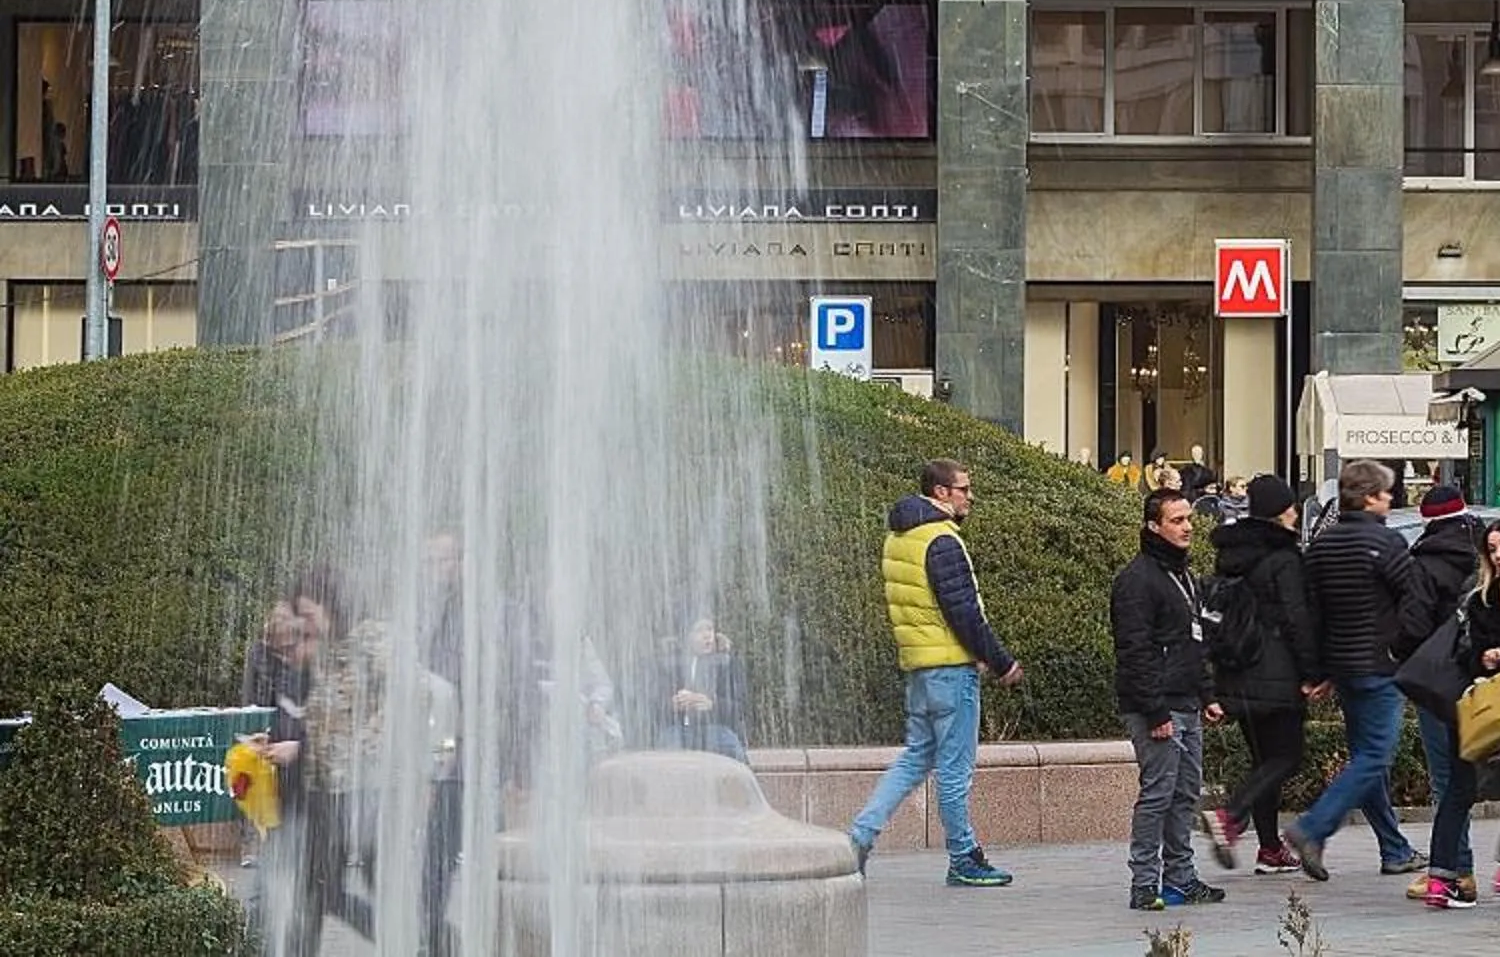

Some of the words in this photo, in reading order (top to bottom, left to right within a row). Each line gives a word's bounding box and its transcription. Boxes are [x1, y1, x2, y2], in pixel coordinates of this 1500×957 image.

[309, 204, 425, 217] LIVIAN
[679, 205, 801, 218] LIVIANA
[825, 205, 918, 218] CONTI
[1221, 259, 1278, 301] M
[826, 308, 855, 346] P
[1345, 430, 1437, 444] PROSECCO
[1441, 431, 1453, 444] &
[139, 732, 214, 750] COMUNITÀ
